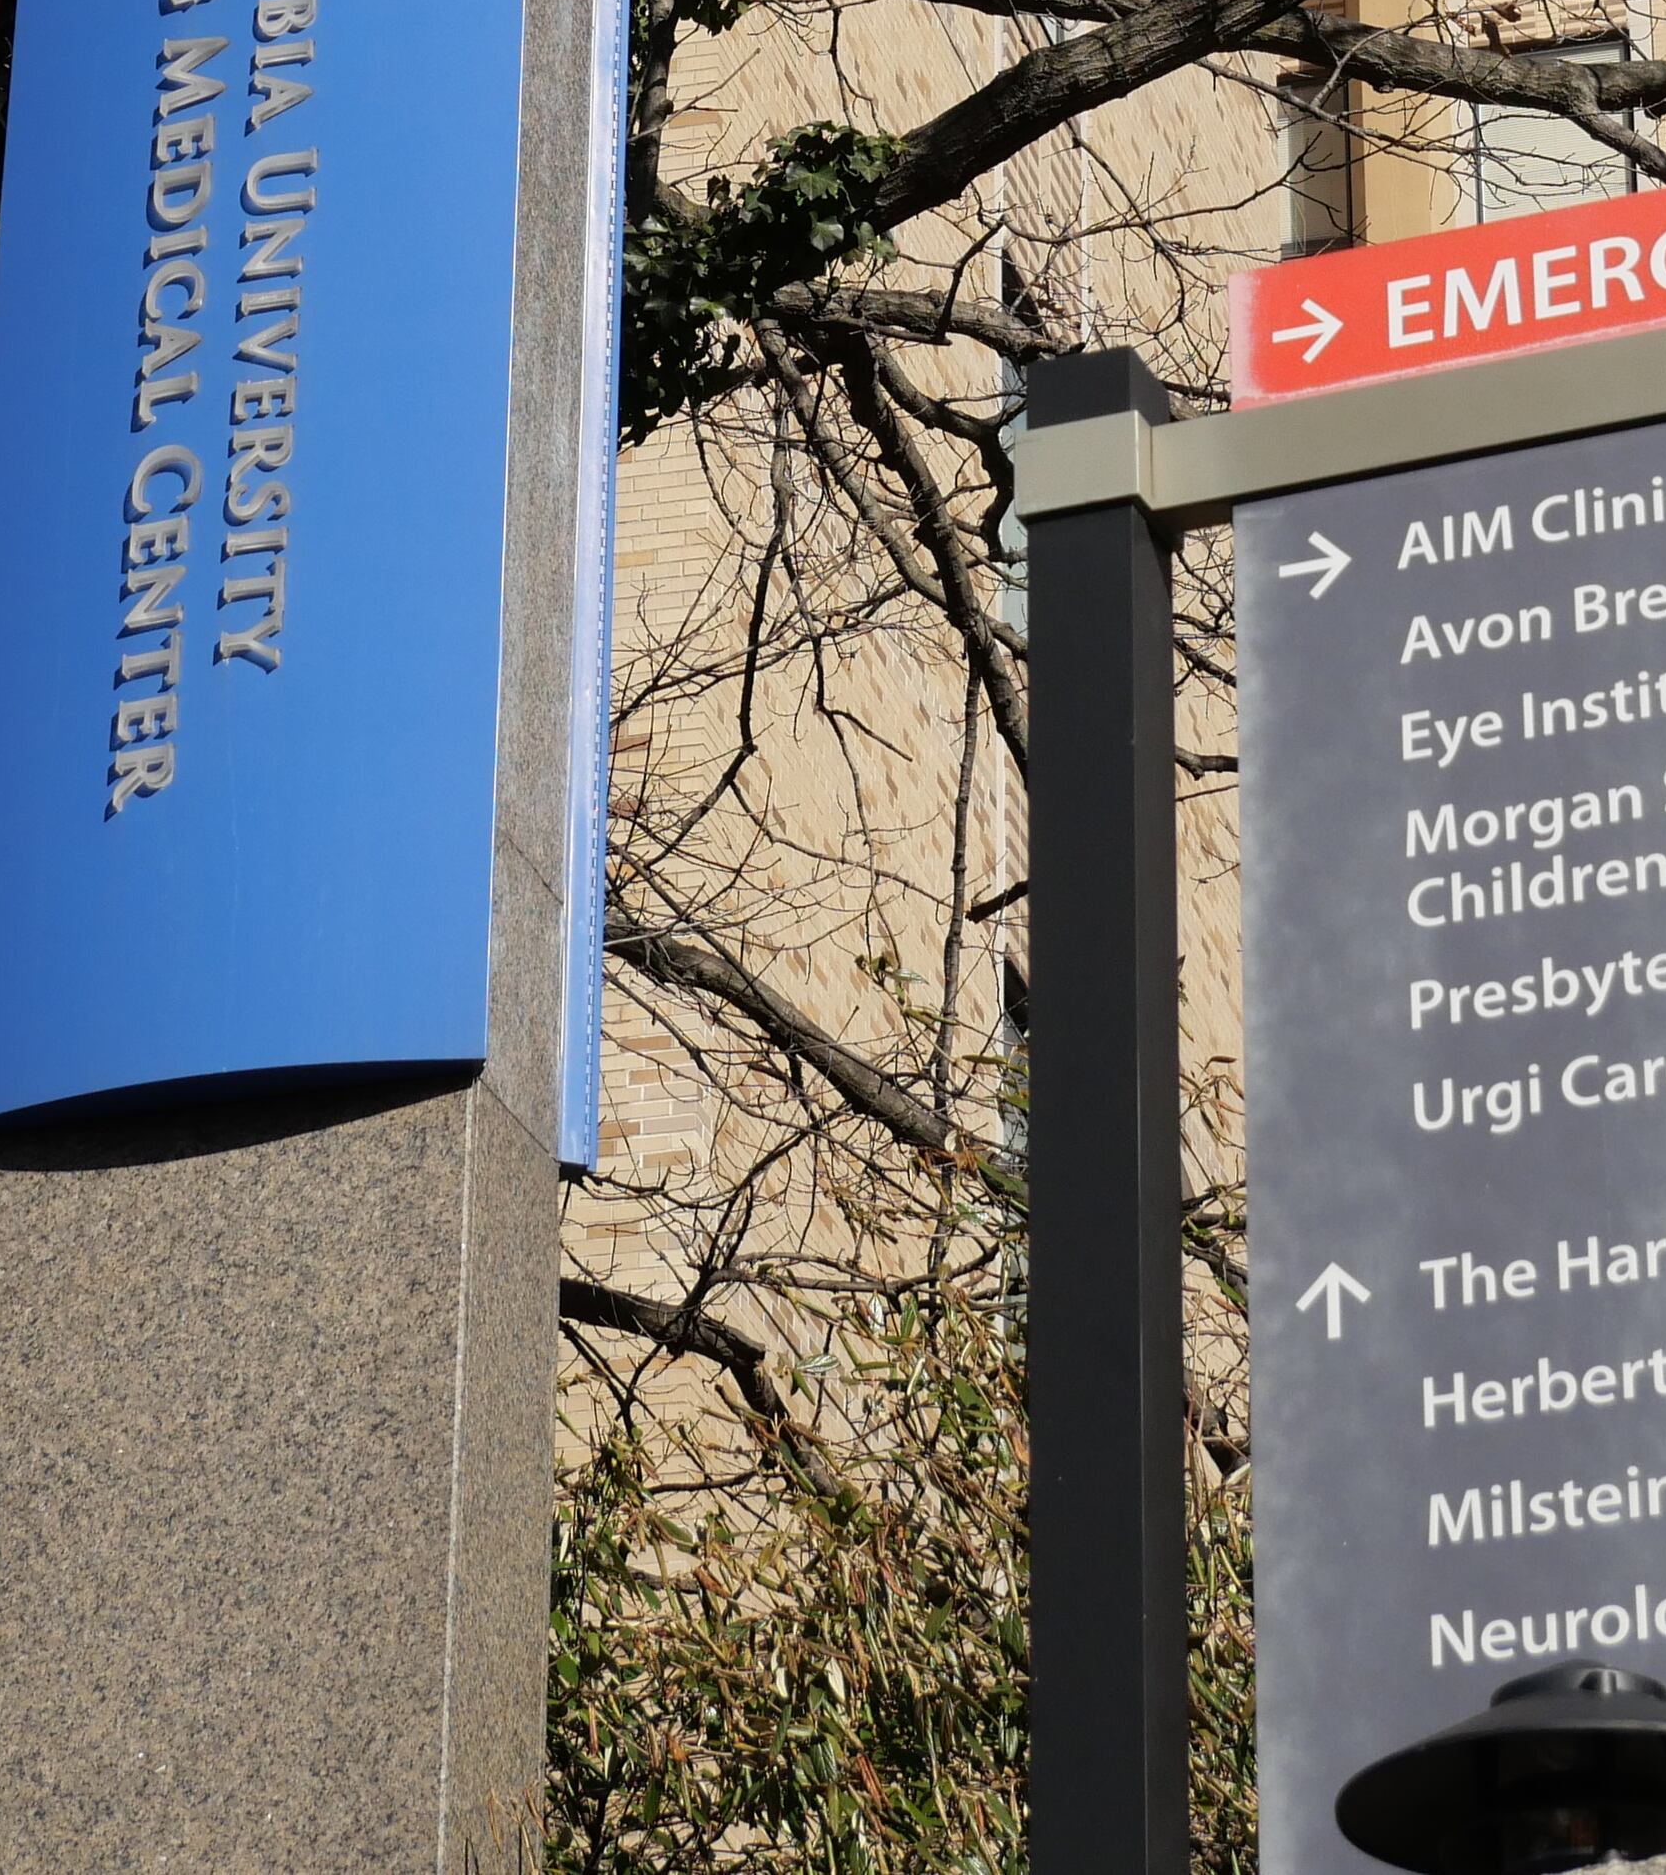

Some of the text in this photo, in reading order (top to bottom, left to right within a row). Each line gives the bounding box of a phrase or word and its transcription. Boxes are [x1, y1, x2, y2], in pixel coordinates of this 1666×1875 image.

[138, 37, 229, 425] MEDICAL
[219, 146, 319, 673] UNIVERSITY
[1398, 505, 1513, 569] AIM
[112, 444, 203, 815] CENTER
[1401, 606, 1551, 664] Avon
[1402, 710, 1503, 767] Eye
[1406, 785, 1642, 857] Morgan
[1414, 1064, 1541, 1134] Urgi
[1420, 1252, 1537, 1309] The
